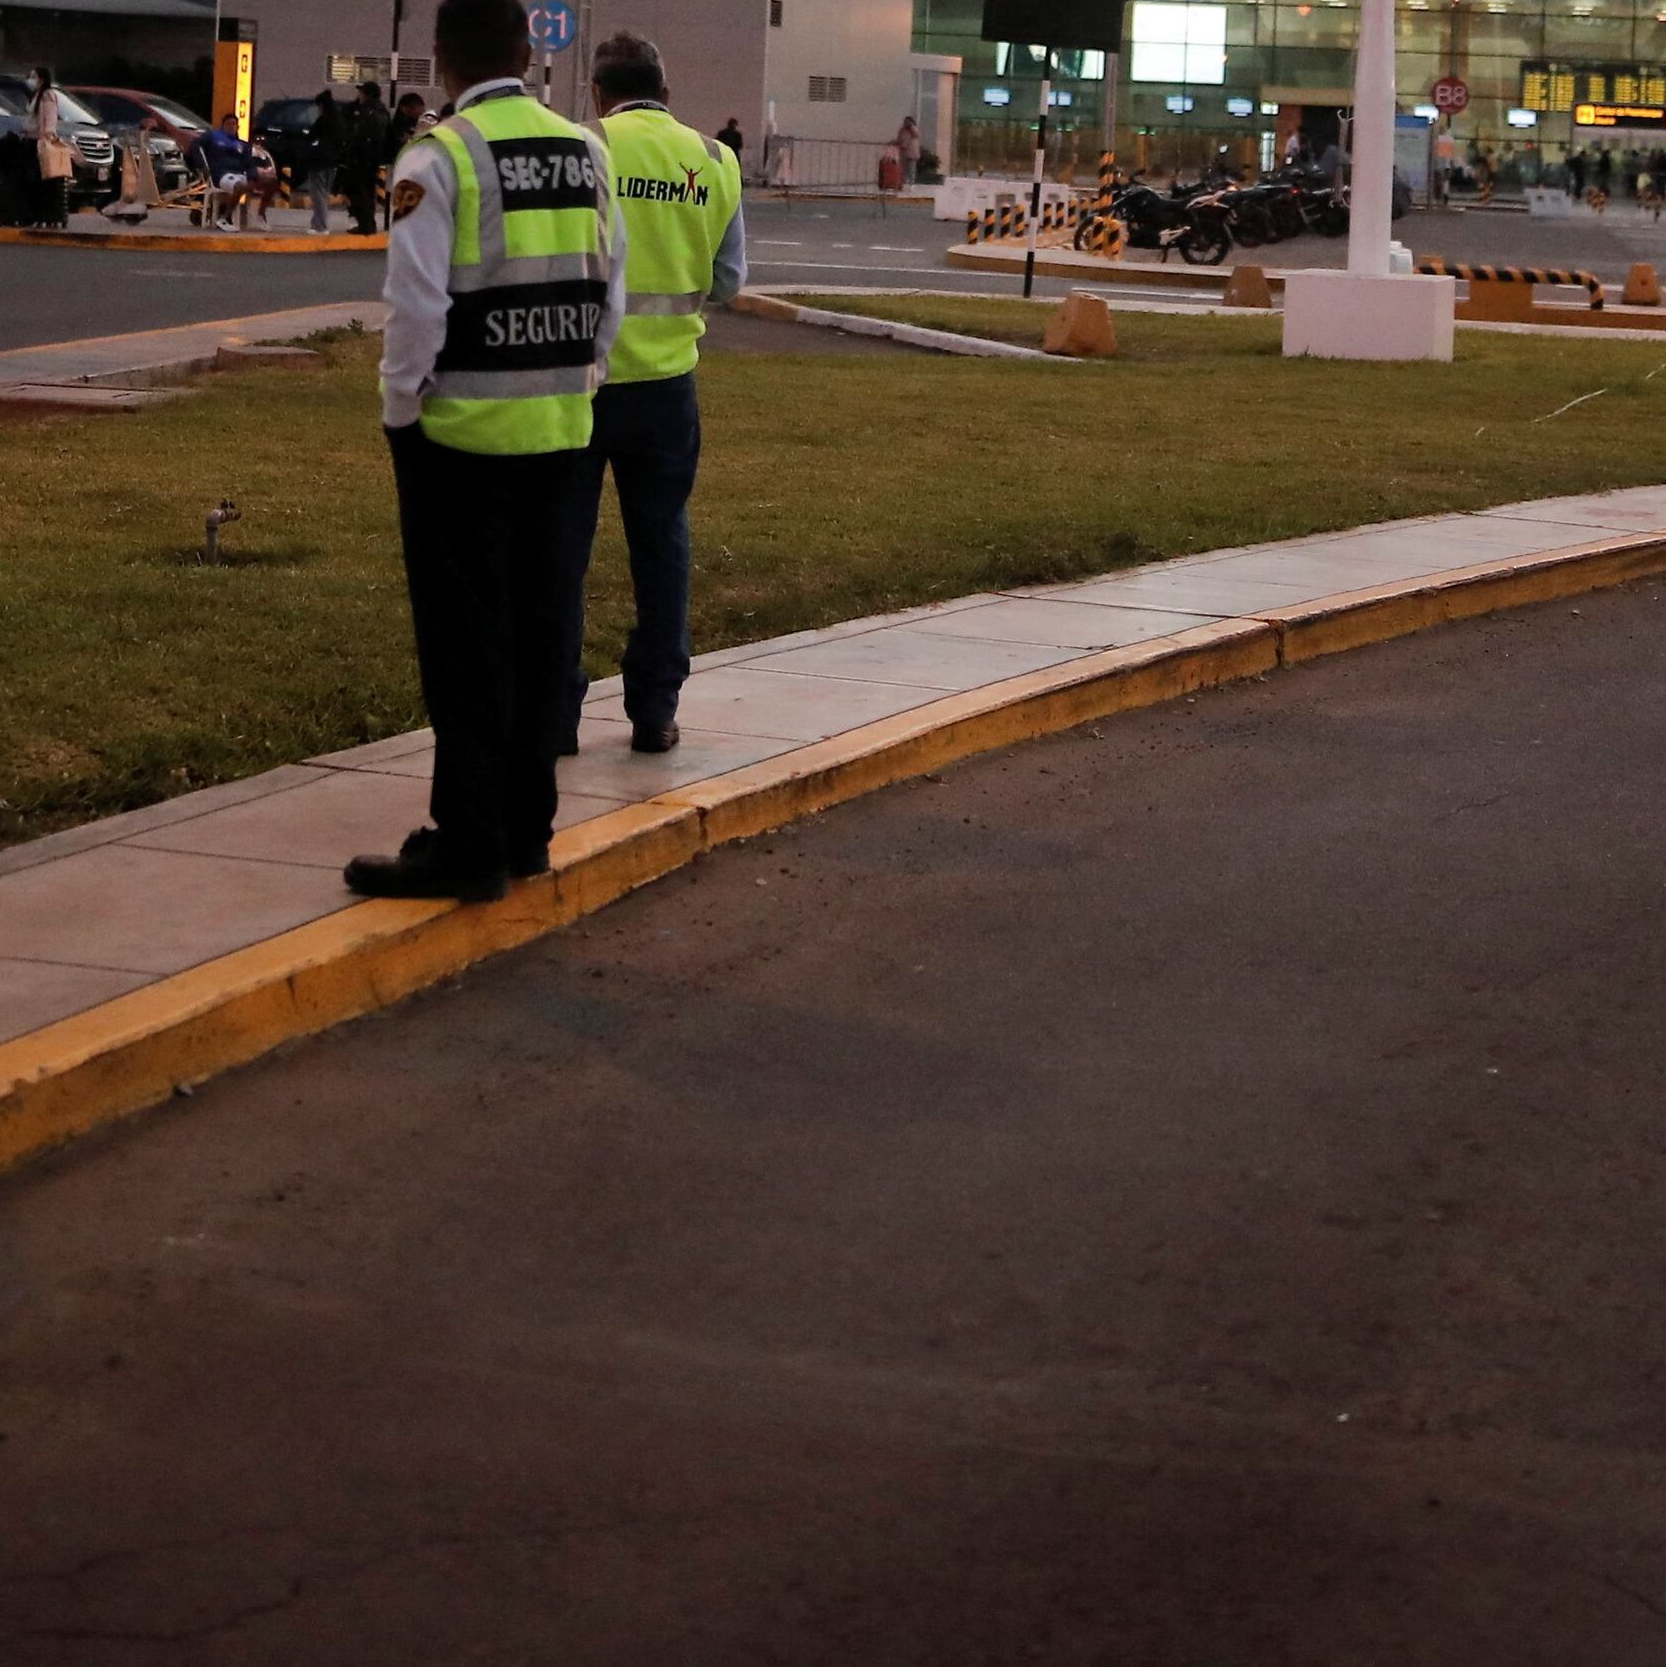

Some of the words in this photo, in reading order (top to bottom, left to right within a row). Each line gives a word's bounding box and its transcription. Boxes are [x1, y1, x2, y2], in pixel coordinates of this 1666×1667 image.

[1436, 85, 1466, 105] B8
[500, 154, 595, 191] SEC-786
[617, 162, 708, 207] LIDERMAN
